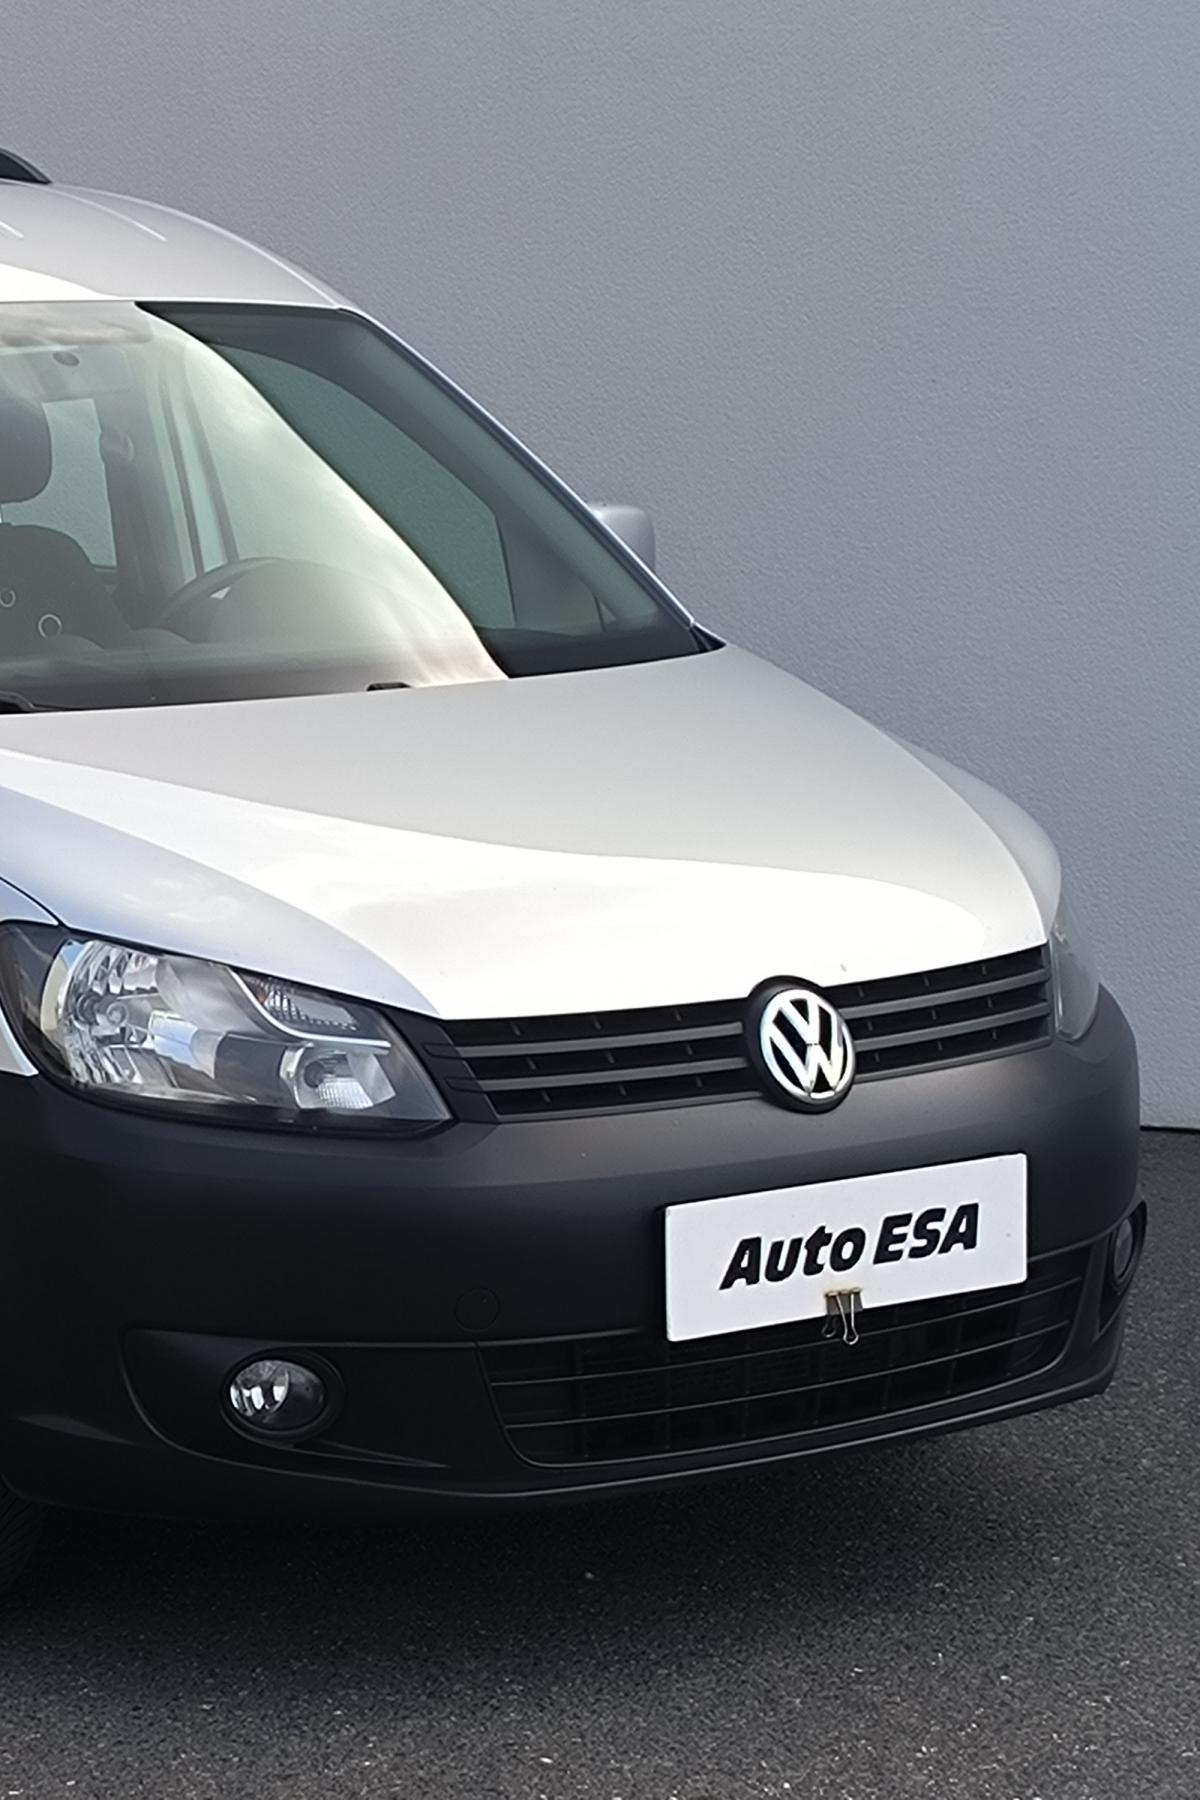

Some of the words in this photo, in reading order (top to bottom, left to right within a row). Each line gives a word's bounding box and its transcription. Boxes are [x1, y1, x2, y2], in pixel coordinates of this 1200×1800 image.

[762, 990, 853, 1101] VW
[718, 1225, 866, 1291] Auto
[872, 1202, 979, 1265] ESA
